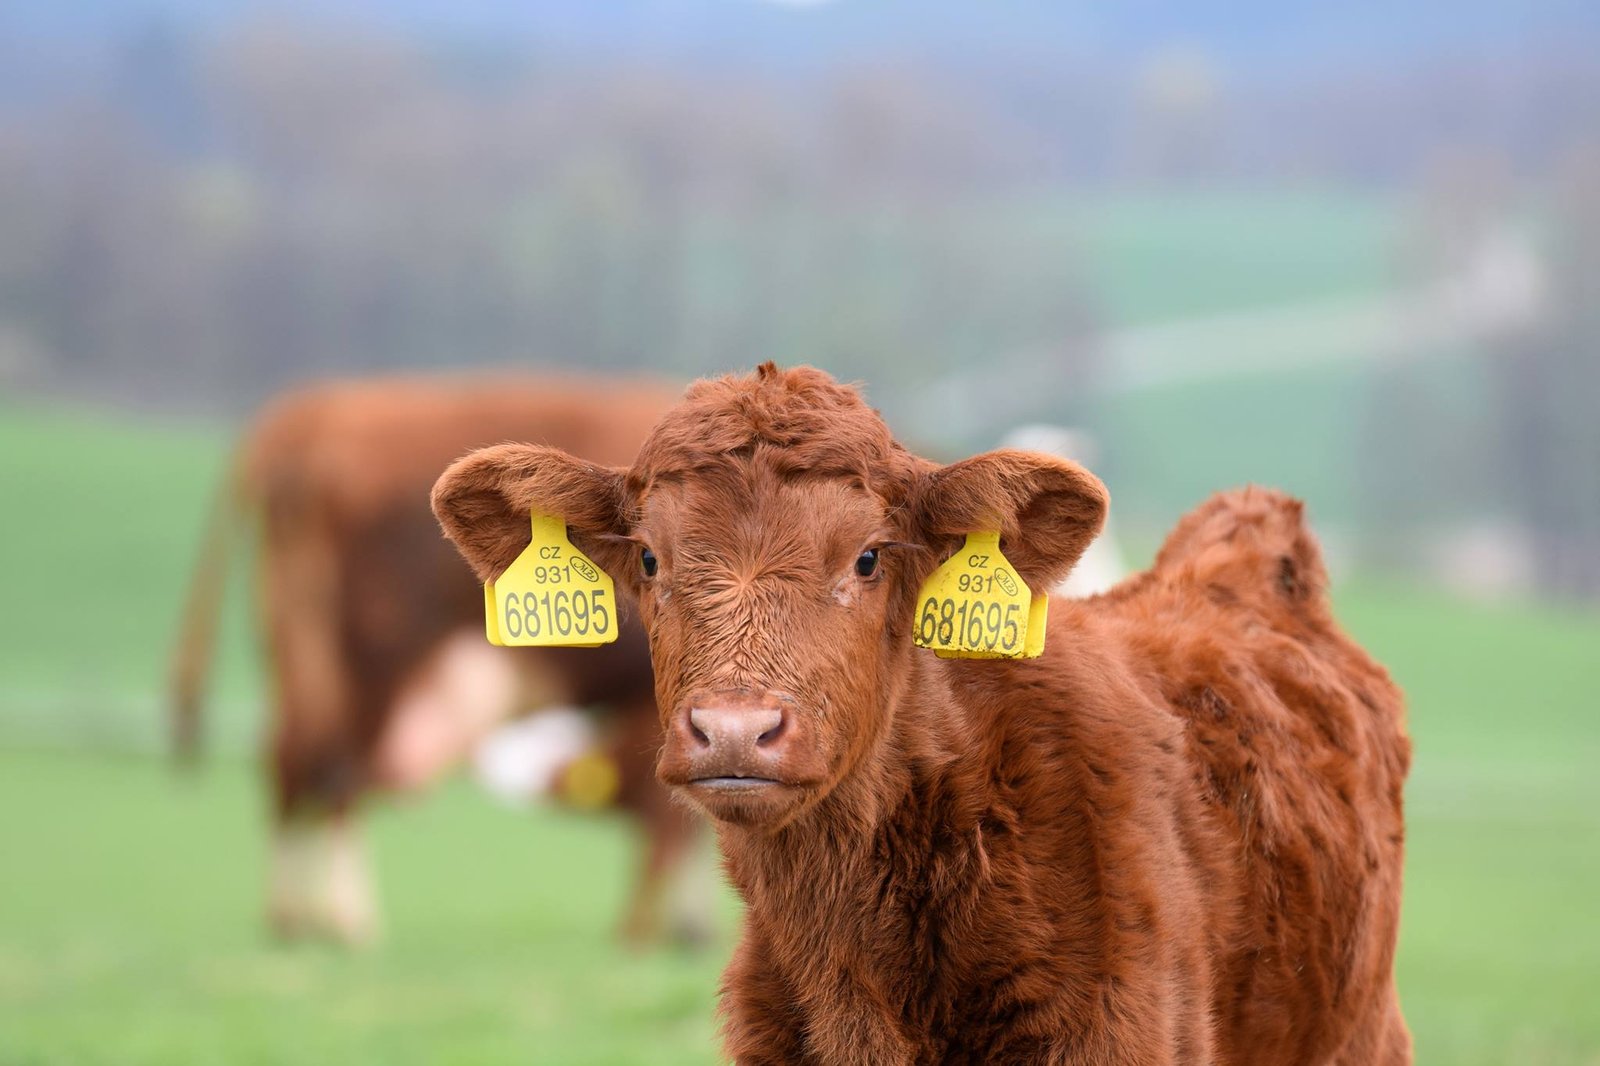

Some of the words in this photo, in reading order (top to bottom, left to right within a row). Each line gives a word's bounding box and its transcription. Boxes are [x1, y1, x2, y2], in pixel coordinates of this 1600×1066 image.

[540, 546, 561, 559] CZ
[968, 555, 989, 568] CZ
[535, 565, 570, 584] 931
[958, 574, 993, 593] 931
[505, 589, 608, 637] 681695
[920, 597, 1020, 650] 681695
